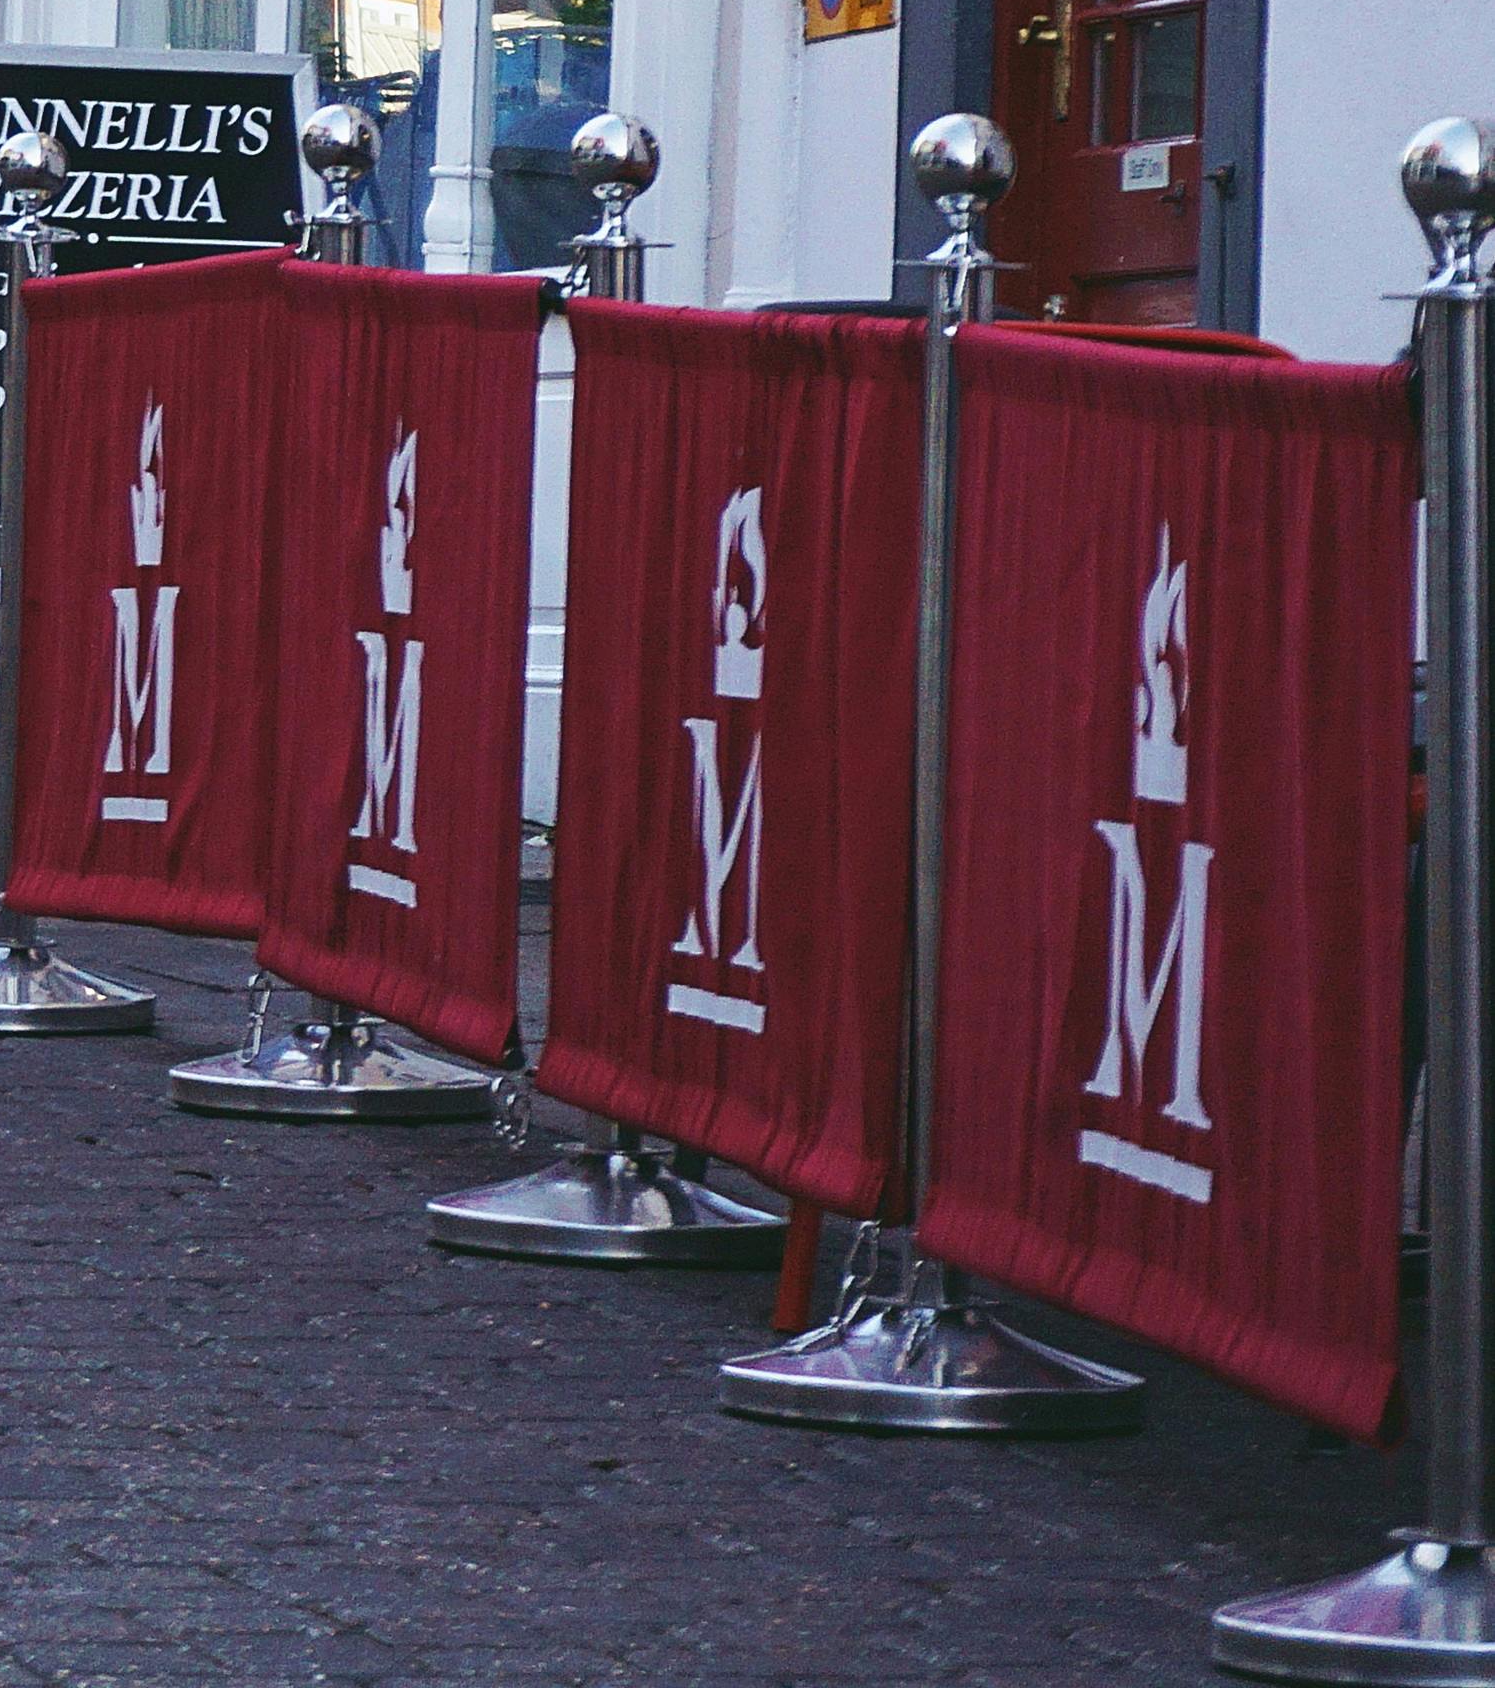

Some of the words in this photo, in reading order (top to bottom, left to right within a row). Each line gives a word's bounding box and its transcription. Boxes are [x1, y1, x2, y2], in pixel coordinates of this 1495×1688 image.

[104, 585, 180, 773] M
[349, 631, 425, 853] M
[672, 718, 765, 972] M
[1084, 821, 1214, 1129] M
